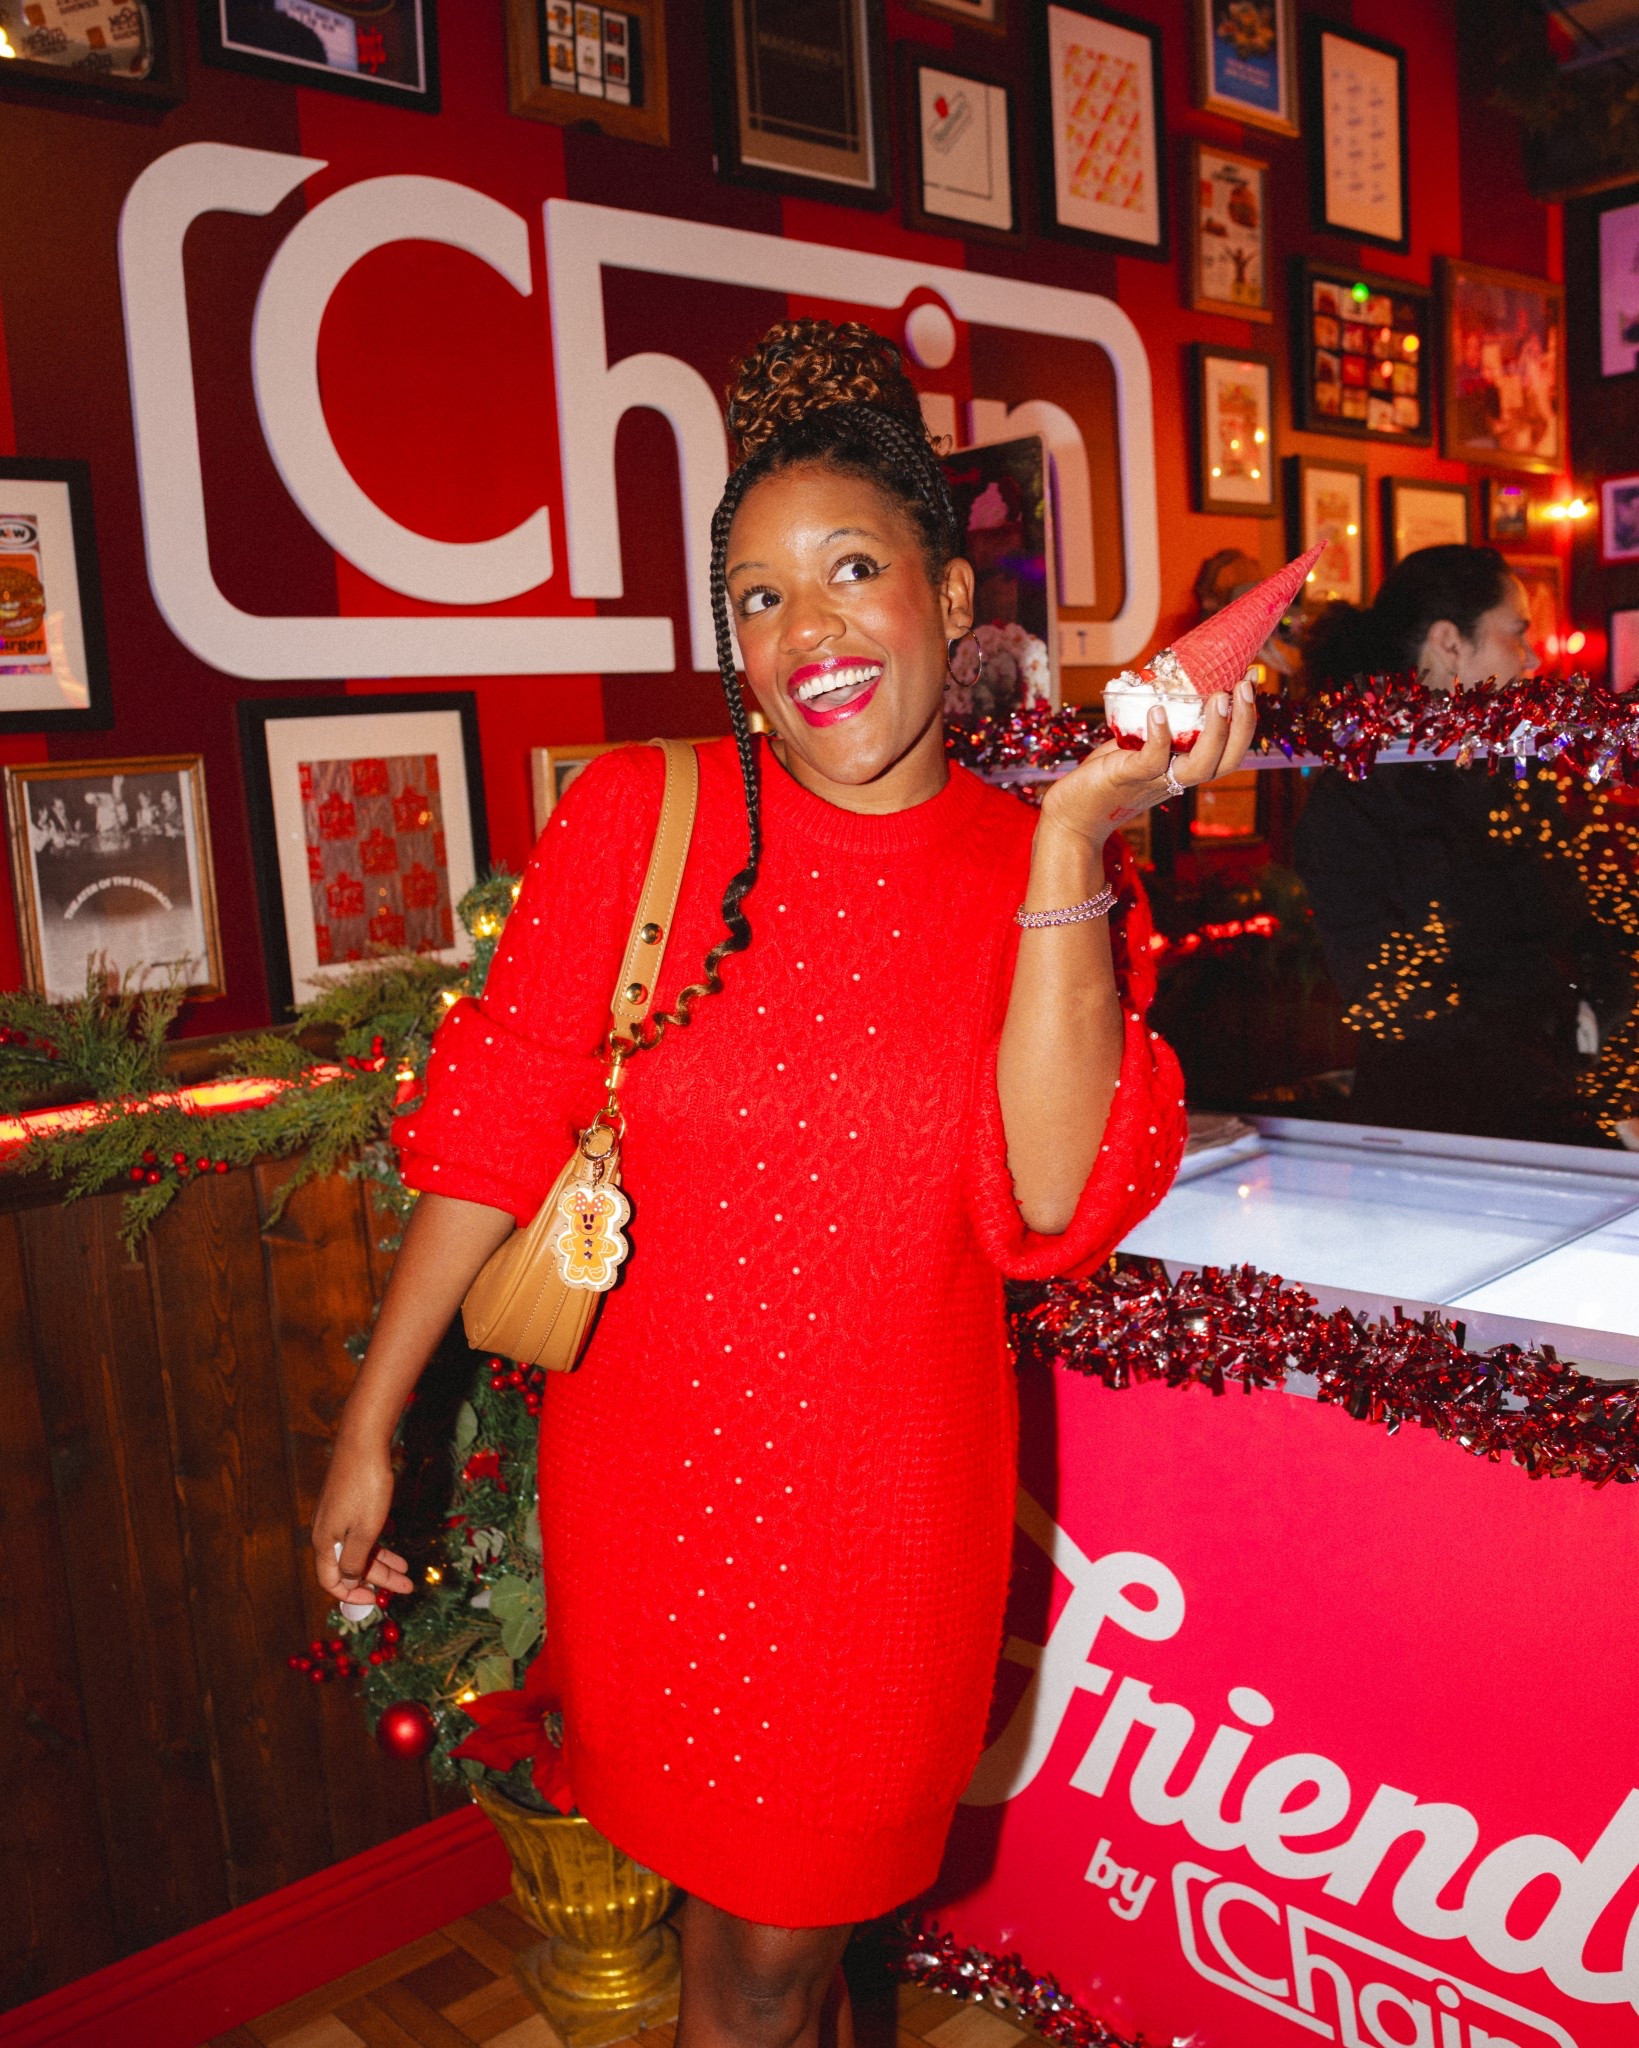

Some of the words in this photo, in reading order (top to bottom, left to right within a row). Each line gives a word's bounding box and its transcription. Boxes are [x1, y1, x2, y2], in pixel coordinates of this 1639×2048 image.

[250, 174, 1097, 672] Chn
[97, 877, 112, 890] OF
[111, 875, 132, 887] THE
[132, 876, 174, 912] STOMACH
[957, 1486, 1639, 2018] friend
[1084, 1838, 1157, 1921] by
[1202, 1881, 1523, 2048] Chai
